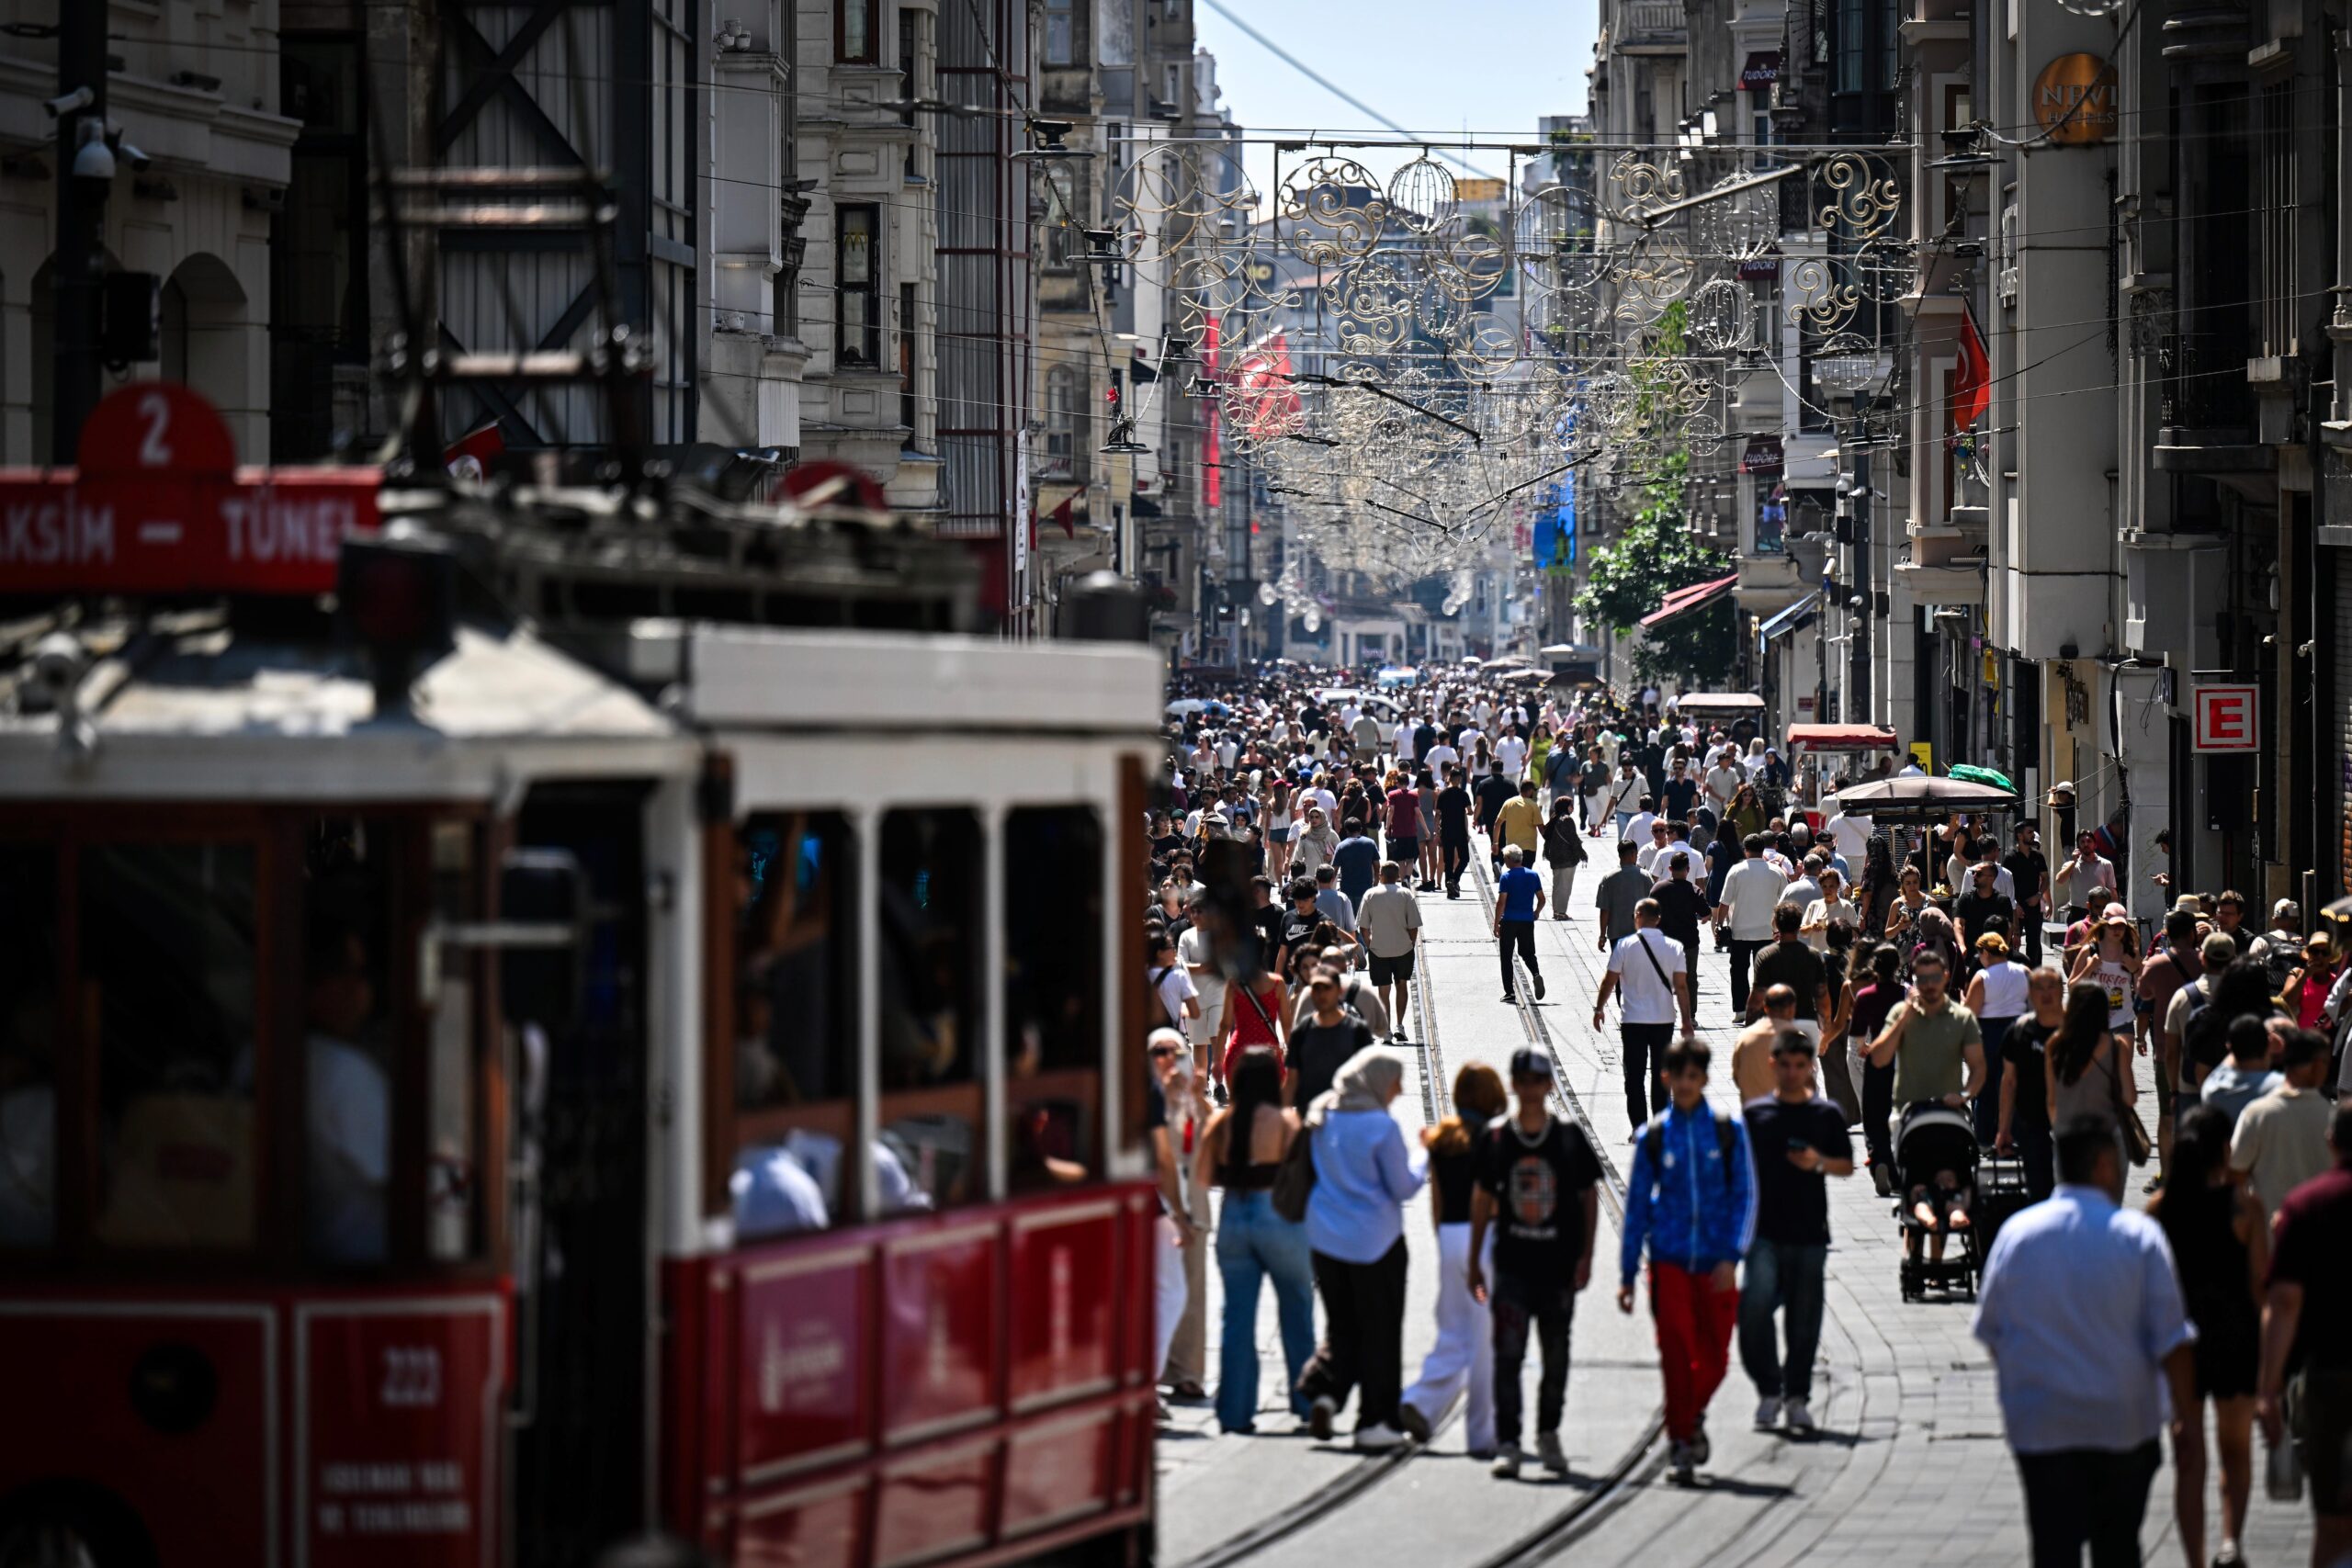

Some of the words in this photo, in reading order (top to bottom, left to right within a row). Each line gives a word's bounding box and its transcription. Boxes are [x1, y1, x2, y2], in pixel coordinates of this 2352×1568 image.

[1744, 69, 1777, 81] TUDORS
[1744, 261, 1776, 270] TUDORS
[139, 393, 172, 466] 2
[1746, 453, 1778, 464] TUDORS
[0, 488, 115, 565] KSİM
[2209, 698, 2243, 738] E
[1288, 924, 1308, 934] NIKE
